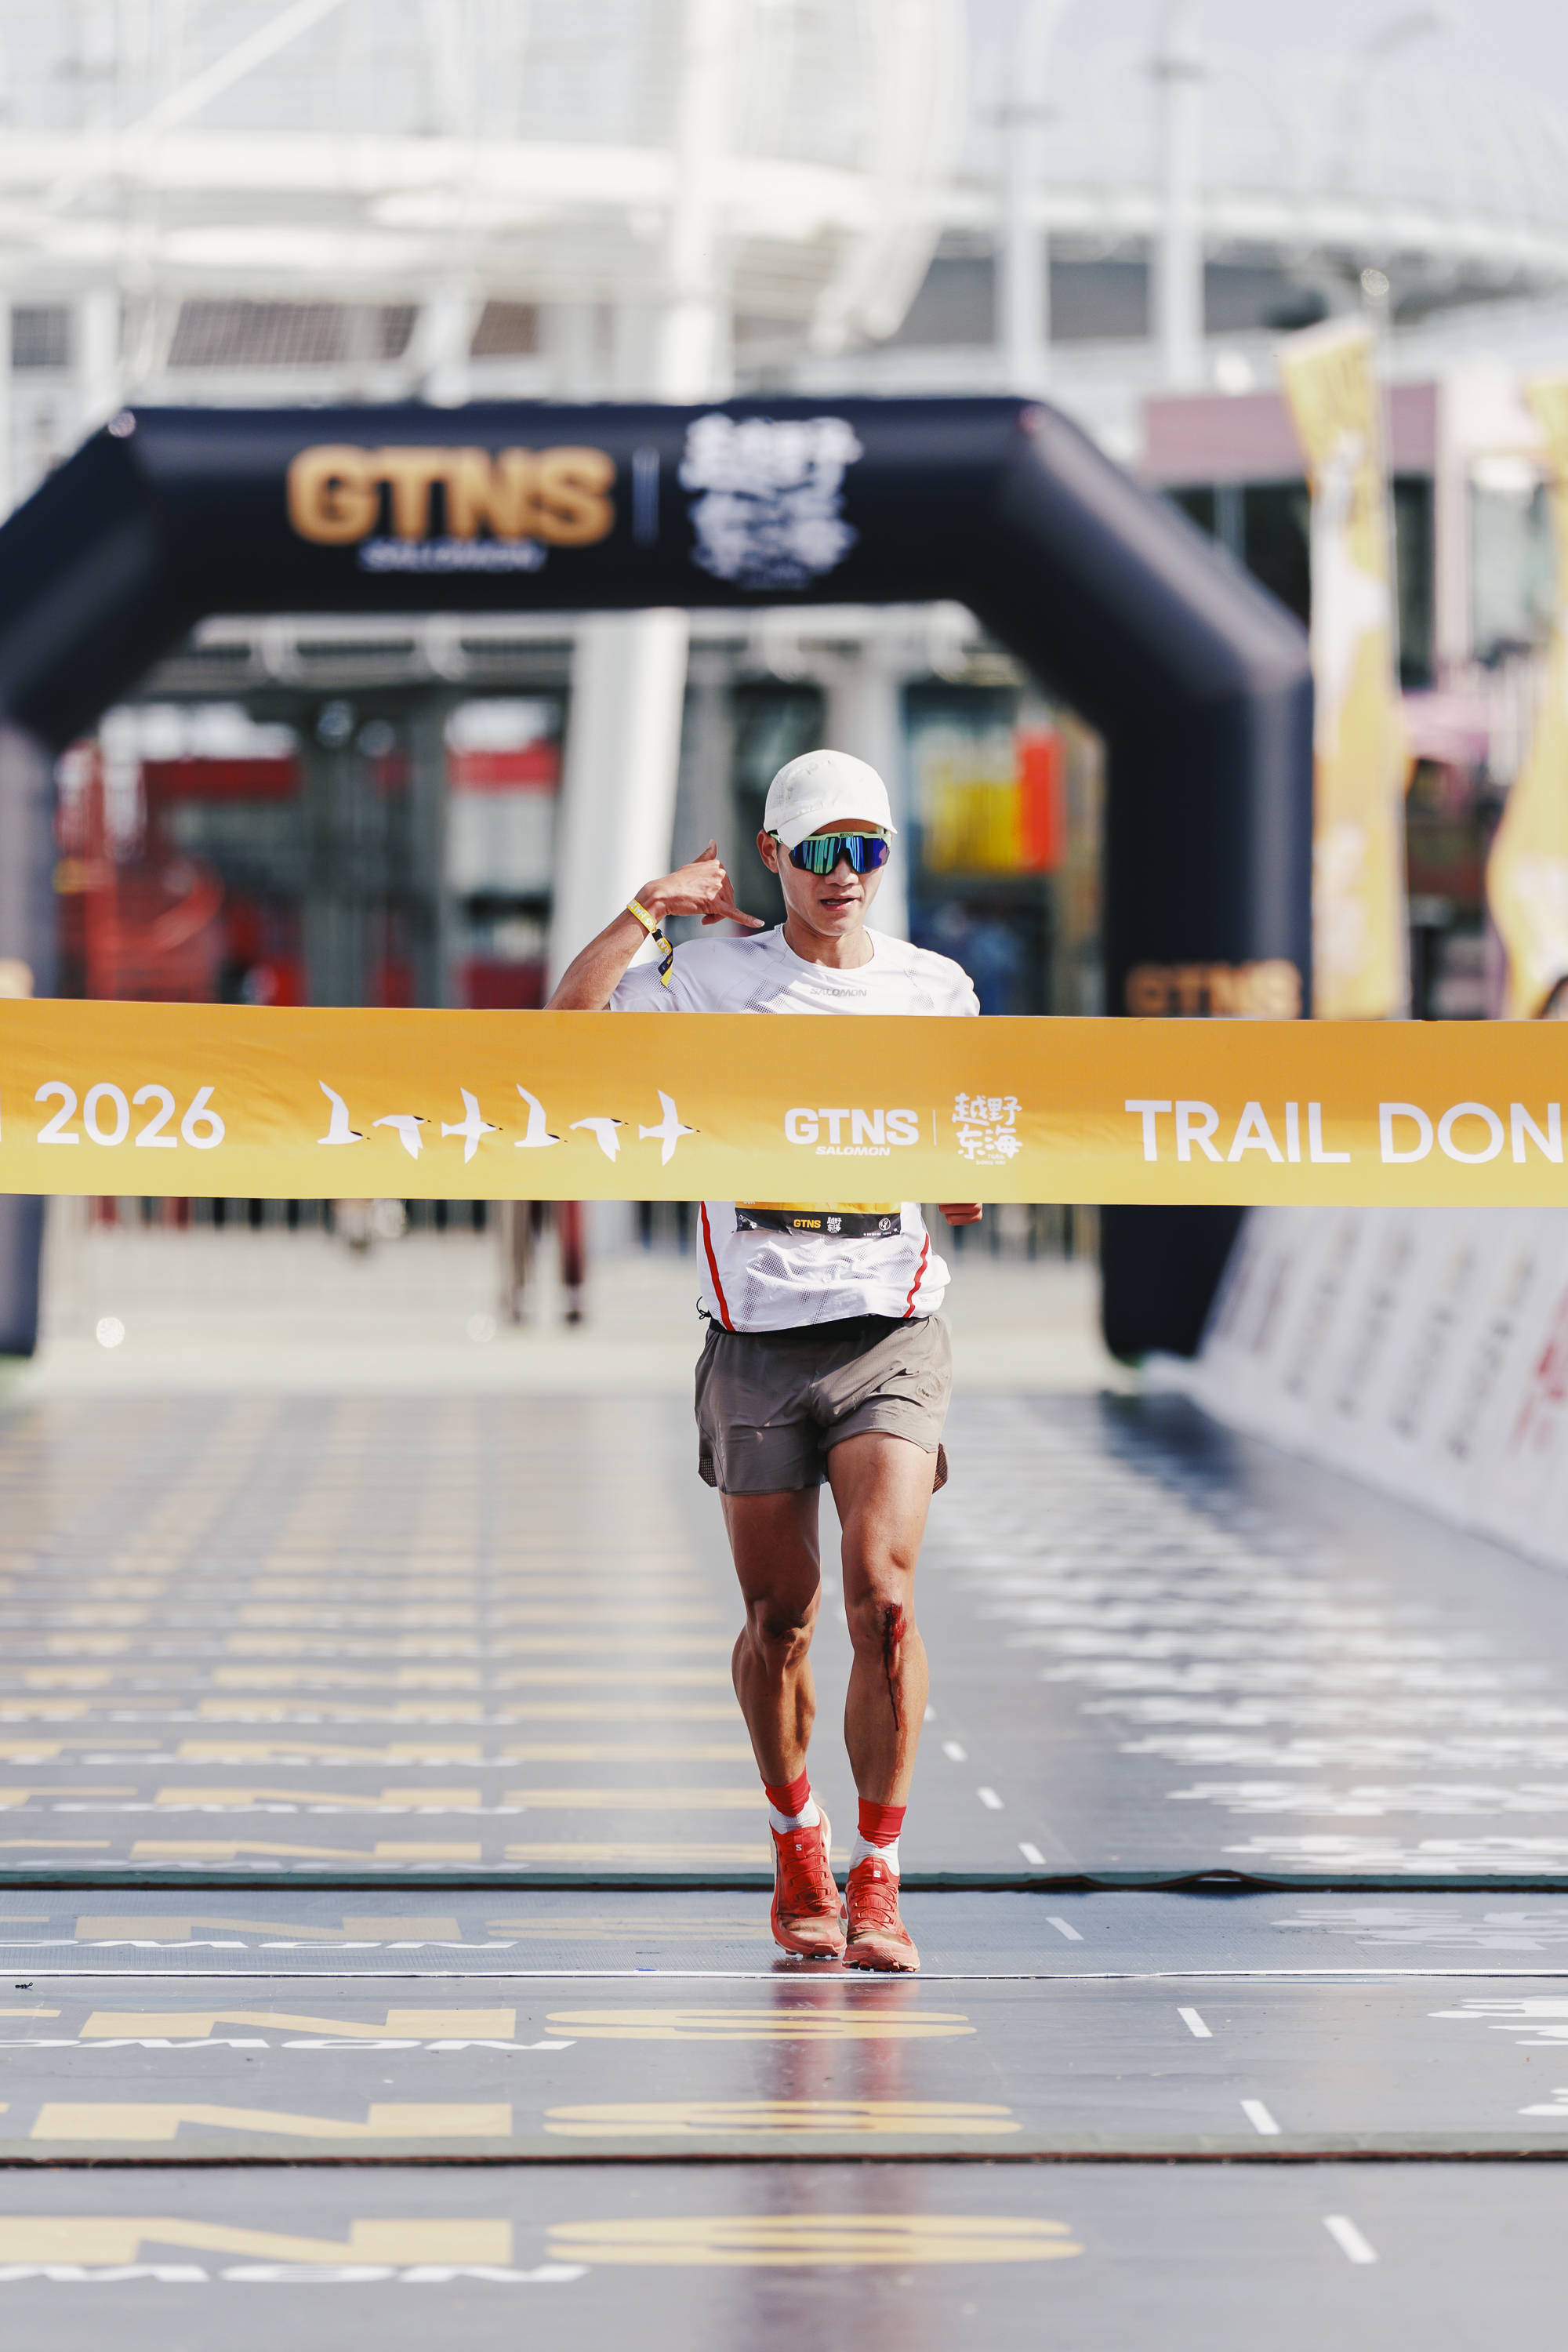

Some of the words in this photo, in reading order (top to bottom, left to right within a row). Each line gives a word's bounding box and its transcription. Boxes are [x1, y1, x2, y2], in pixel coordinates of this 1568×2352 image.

[288, 445, 615, 545] GTNS
[34, 1081, 226, 1149] 2026
[784, 1108, 919, 1145] GTNS
[951, 1092, 1022, 1126] 越野
[956, 1123, 1023, 1160] 东海
[1125, 1099, 1351, 1163] TRAIL
[1378, 1102, 1564, 1164] DON
[815, 1145, 891, 1156] SALOMON
[793, 1218, 822, 1229] GTNS
